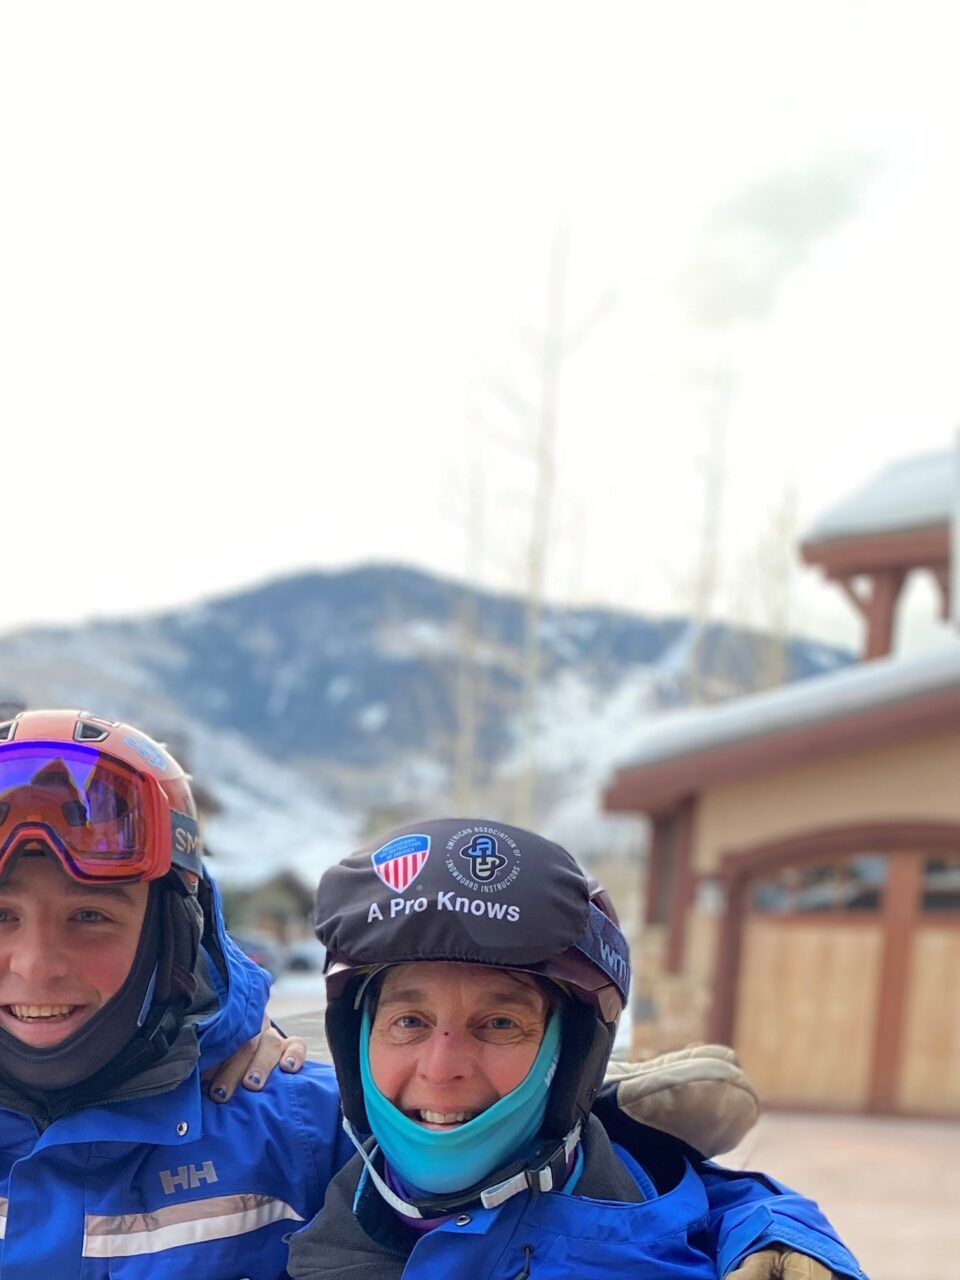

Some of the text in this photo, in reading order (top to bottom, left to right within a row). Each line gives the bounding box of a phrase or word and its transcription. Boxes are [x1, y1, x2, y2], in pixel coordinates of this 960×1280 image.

[474, 826, 518, 849] ASSOCIATION
[512, 848, 522, 858] OF
[445, 859, 521, 893] SNOWBOARD INSTRUCTORS
[367, 891, 521, 923] A Pro Knows
[159, 1160, 219, 1195] HH
